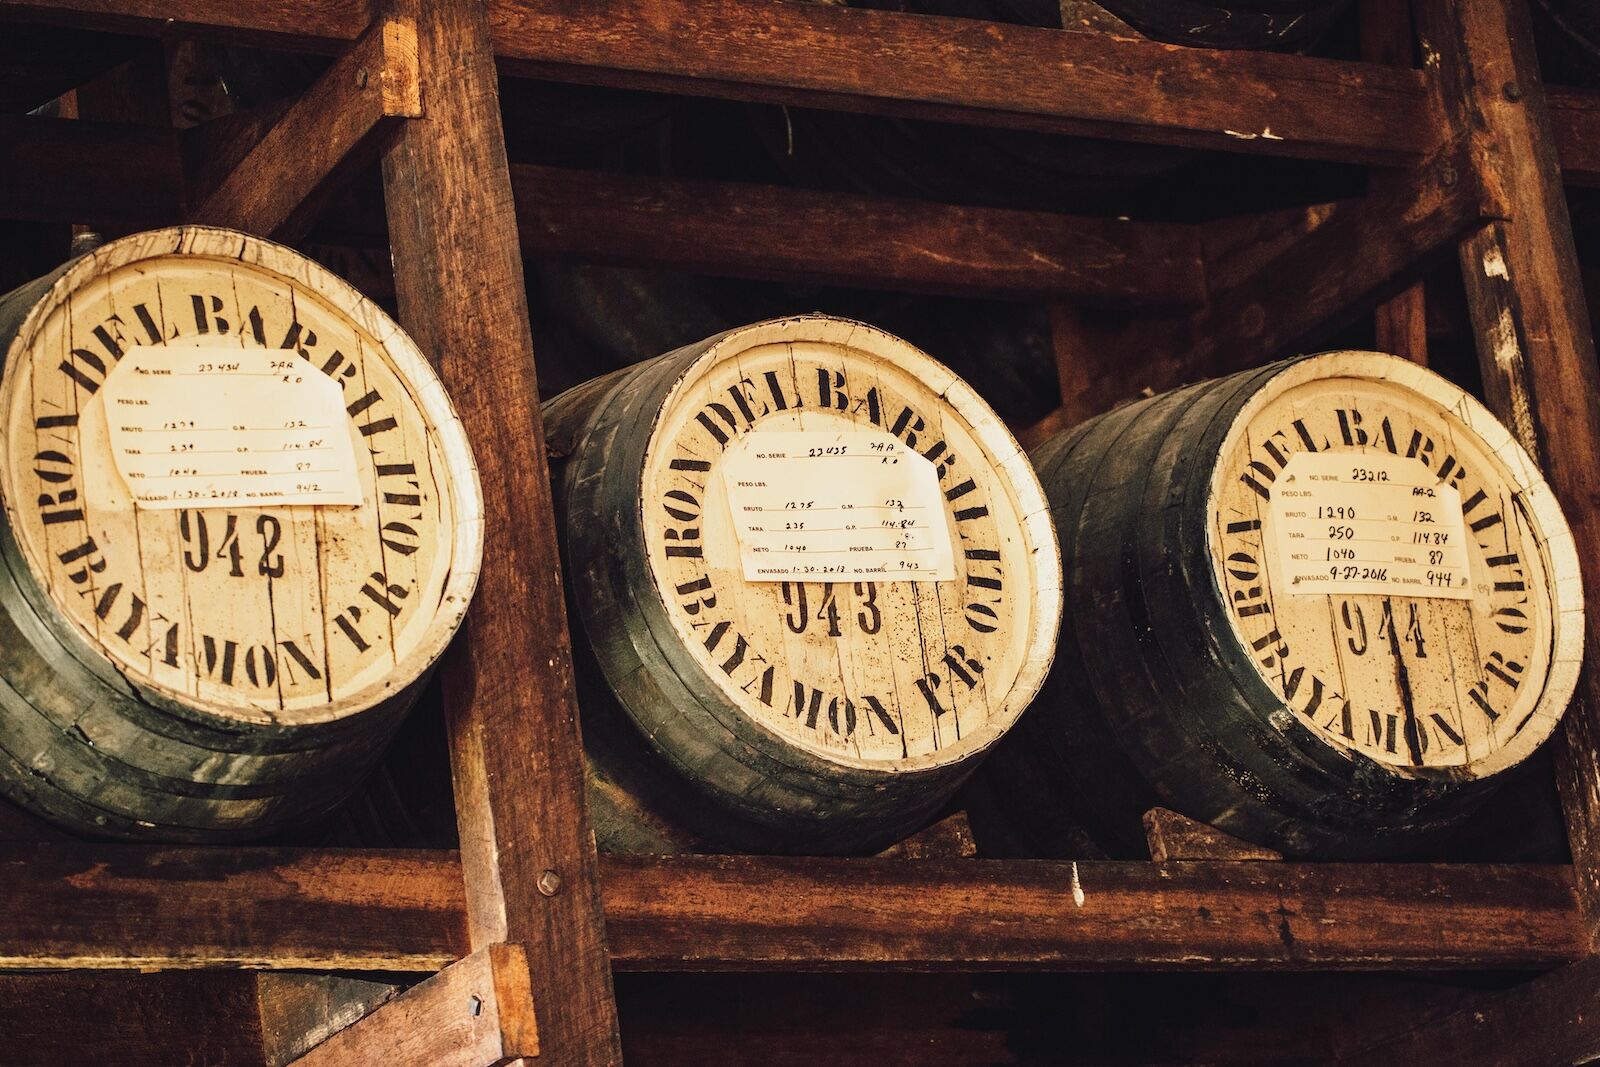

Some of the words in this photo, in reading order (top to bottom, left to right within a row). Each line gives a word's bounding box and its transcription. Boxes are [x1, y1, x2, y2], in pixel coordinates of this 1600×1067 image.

[58, 303, 180, 395] DEL
[189, 293, 422, 556] BARRILITO
[33, 400, 84, 525] RON
[296, 484, 322, 492] 942
[1240, 418, 1331, 503] DEL
[1352, 468, 1391, 482] 23212
[663, 443, 712, 560] RON
[694, 371, 804, 453] DEL
[815, 368, 1003, 633] BARRILITO
[1318, 506, 1355, 519] 1290
[1413, 511, 1435, 522] 132
[1328, 525, 1354, 540] 250
[1413, 531, 1448, 545] 114.84
[1334, 408, 1528, 634] BARRILITO
[179, 509, 285, 578] 942
[784, 544, 807, 553] 1040
[895, 540, 907, 549] 87
[899, 560, 919, 569] 943
[1226, 507, 1271, 617] RON
[1326, 547, 1355, 562] 1040
[1394, 556, 1416, 564] PRUEBA
[1429, 550, 1443, 565] 87
[1330, 566, 1387, 581] 9-27-2016
[1426, 570, 1452, 587] 944
[57, 536, 322, 688] BAYAMON
[781, 581, 882, 638] 943
[1342, 600, 1427, 658] 944
[675, 573, 900, 737] BAYAMON
[1252, 626, 1464, 755] BAYAMON
